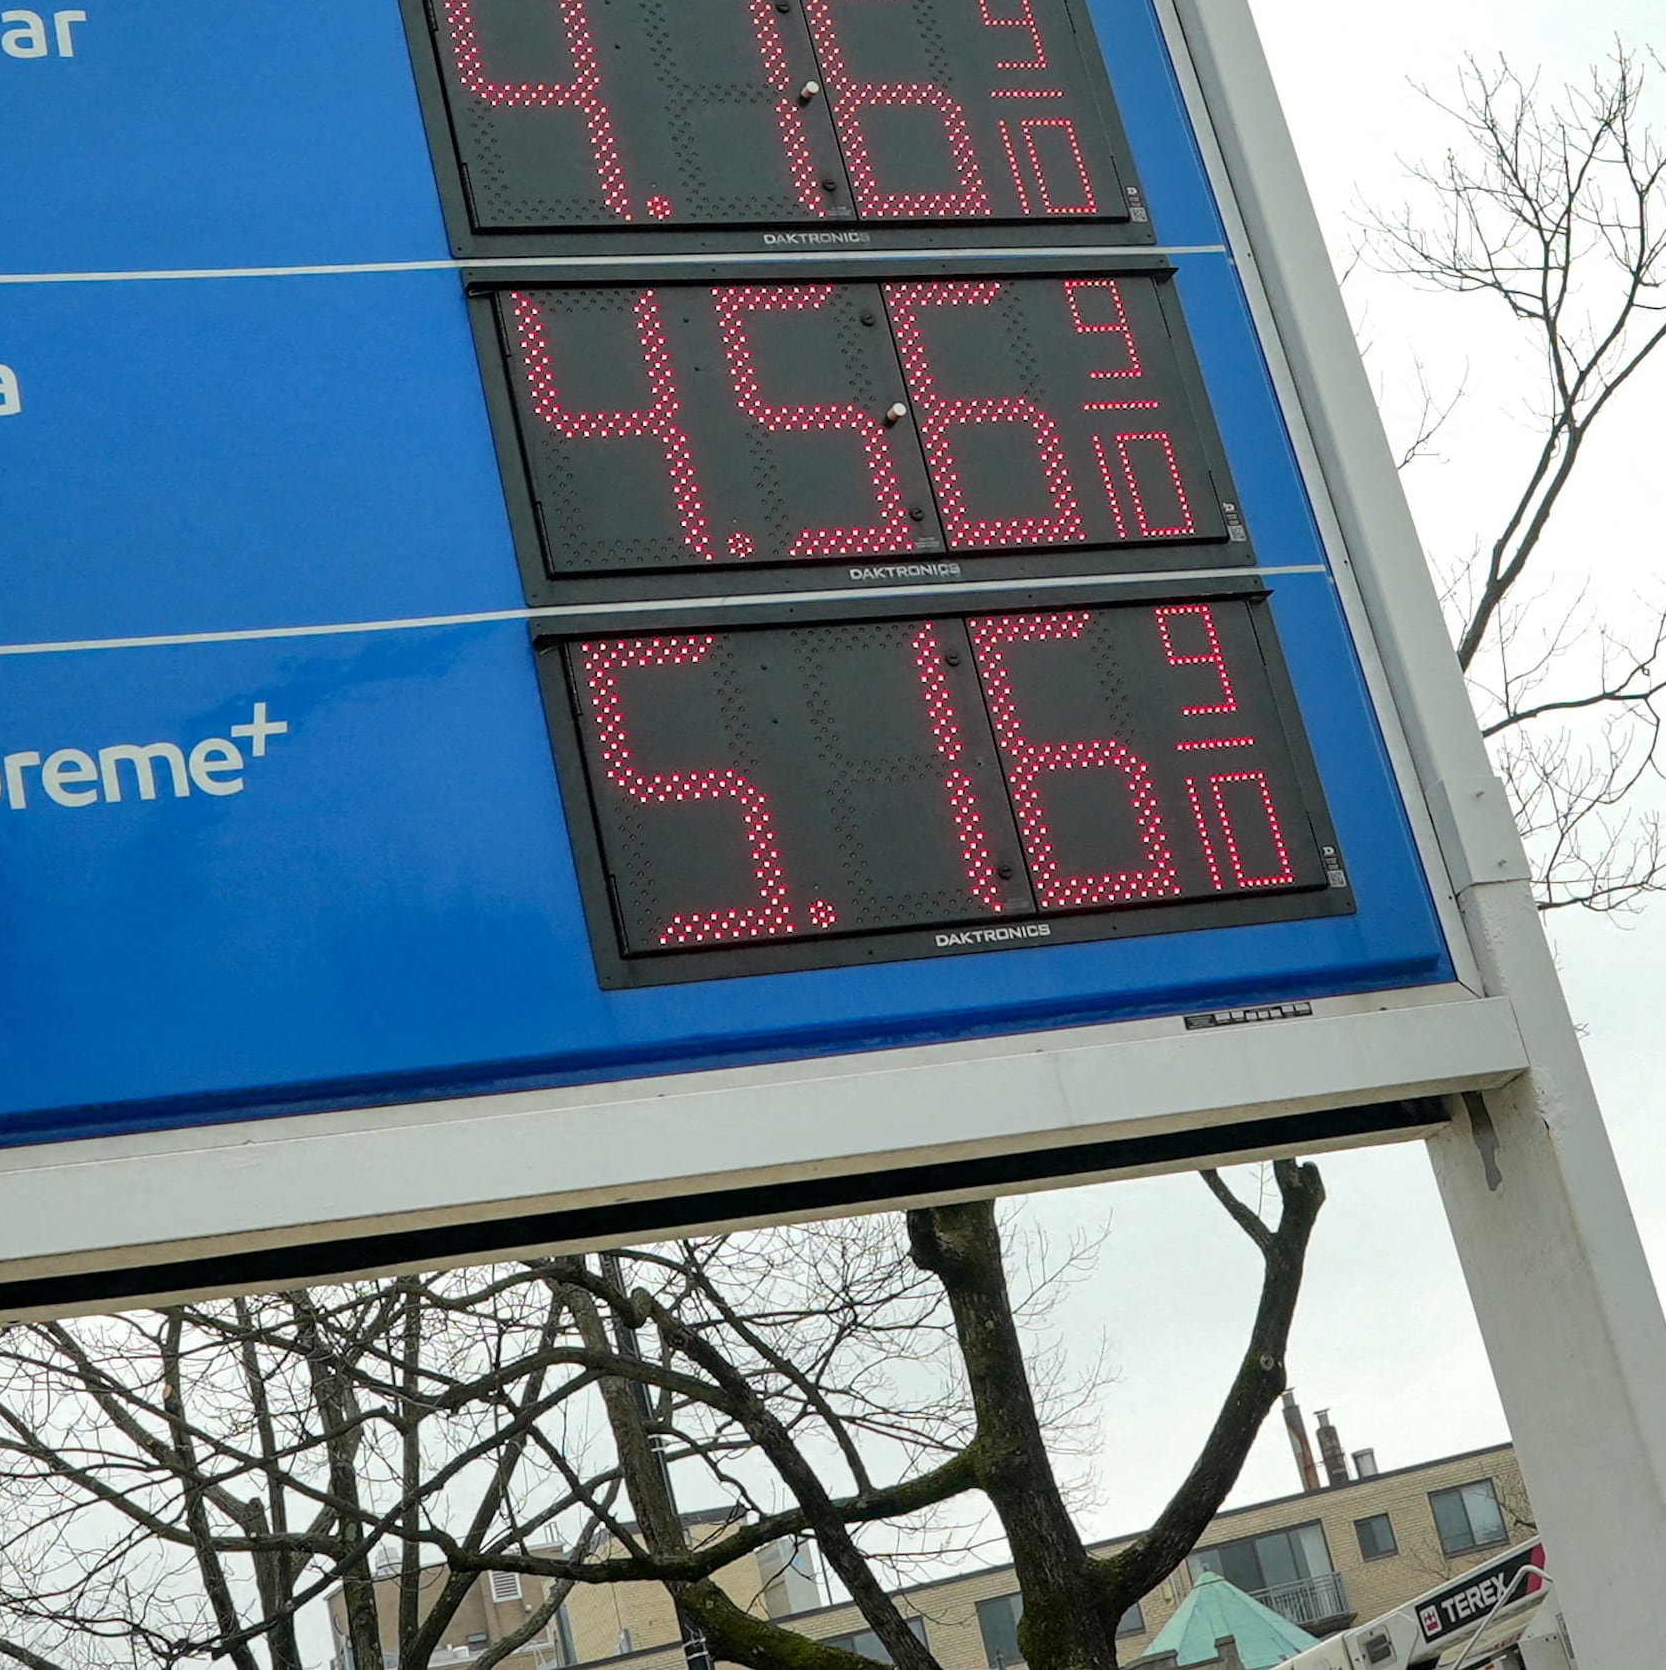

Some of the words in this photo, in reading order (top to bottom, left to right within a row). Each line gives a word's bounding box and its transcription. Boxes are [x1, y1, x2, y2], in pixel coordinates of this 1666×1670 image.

[763, 231, 871, 246] DAKTRONICS
[511, 277, 1088, 560] 4.56
[849, 562, 962, 580] DAKTRONICS
[580, 603, 1183, 944] 5.16
[935, 923, 1052, 947] DAKTRONICS
[1441, 1572, 1509, 1623] TEREX
